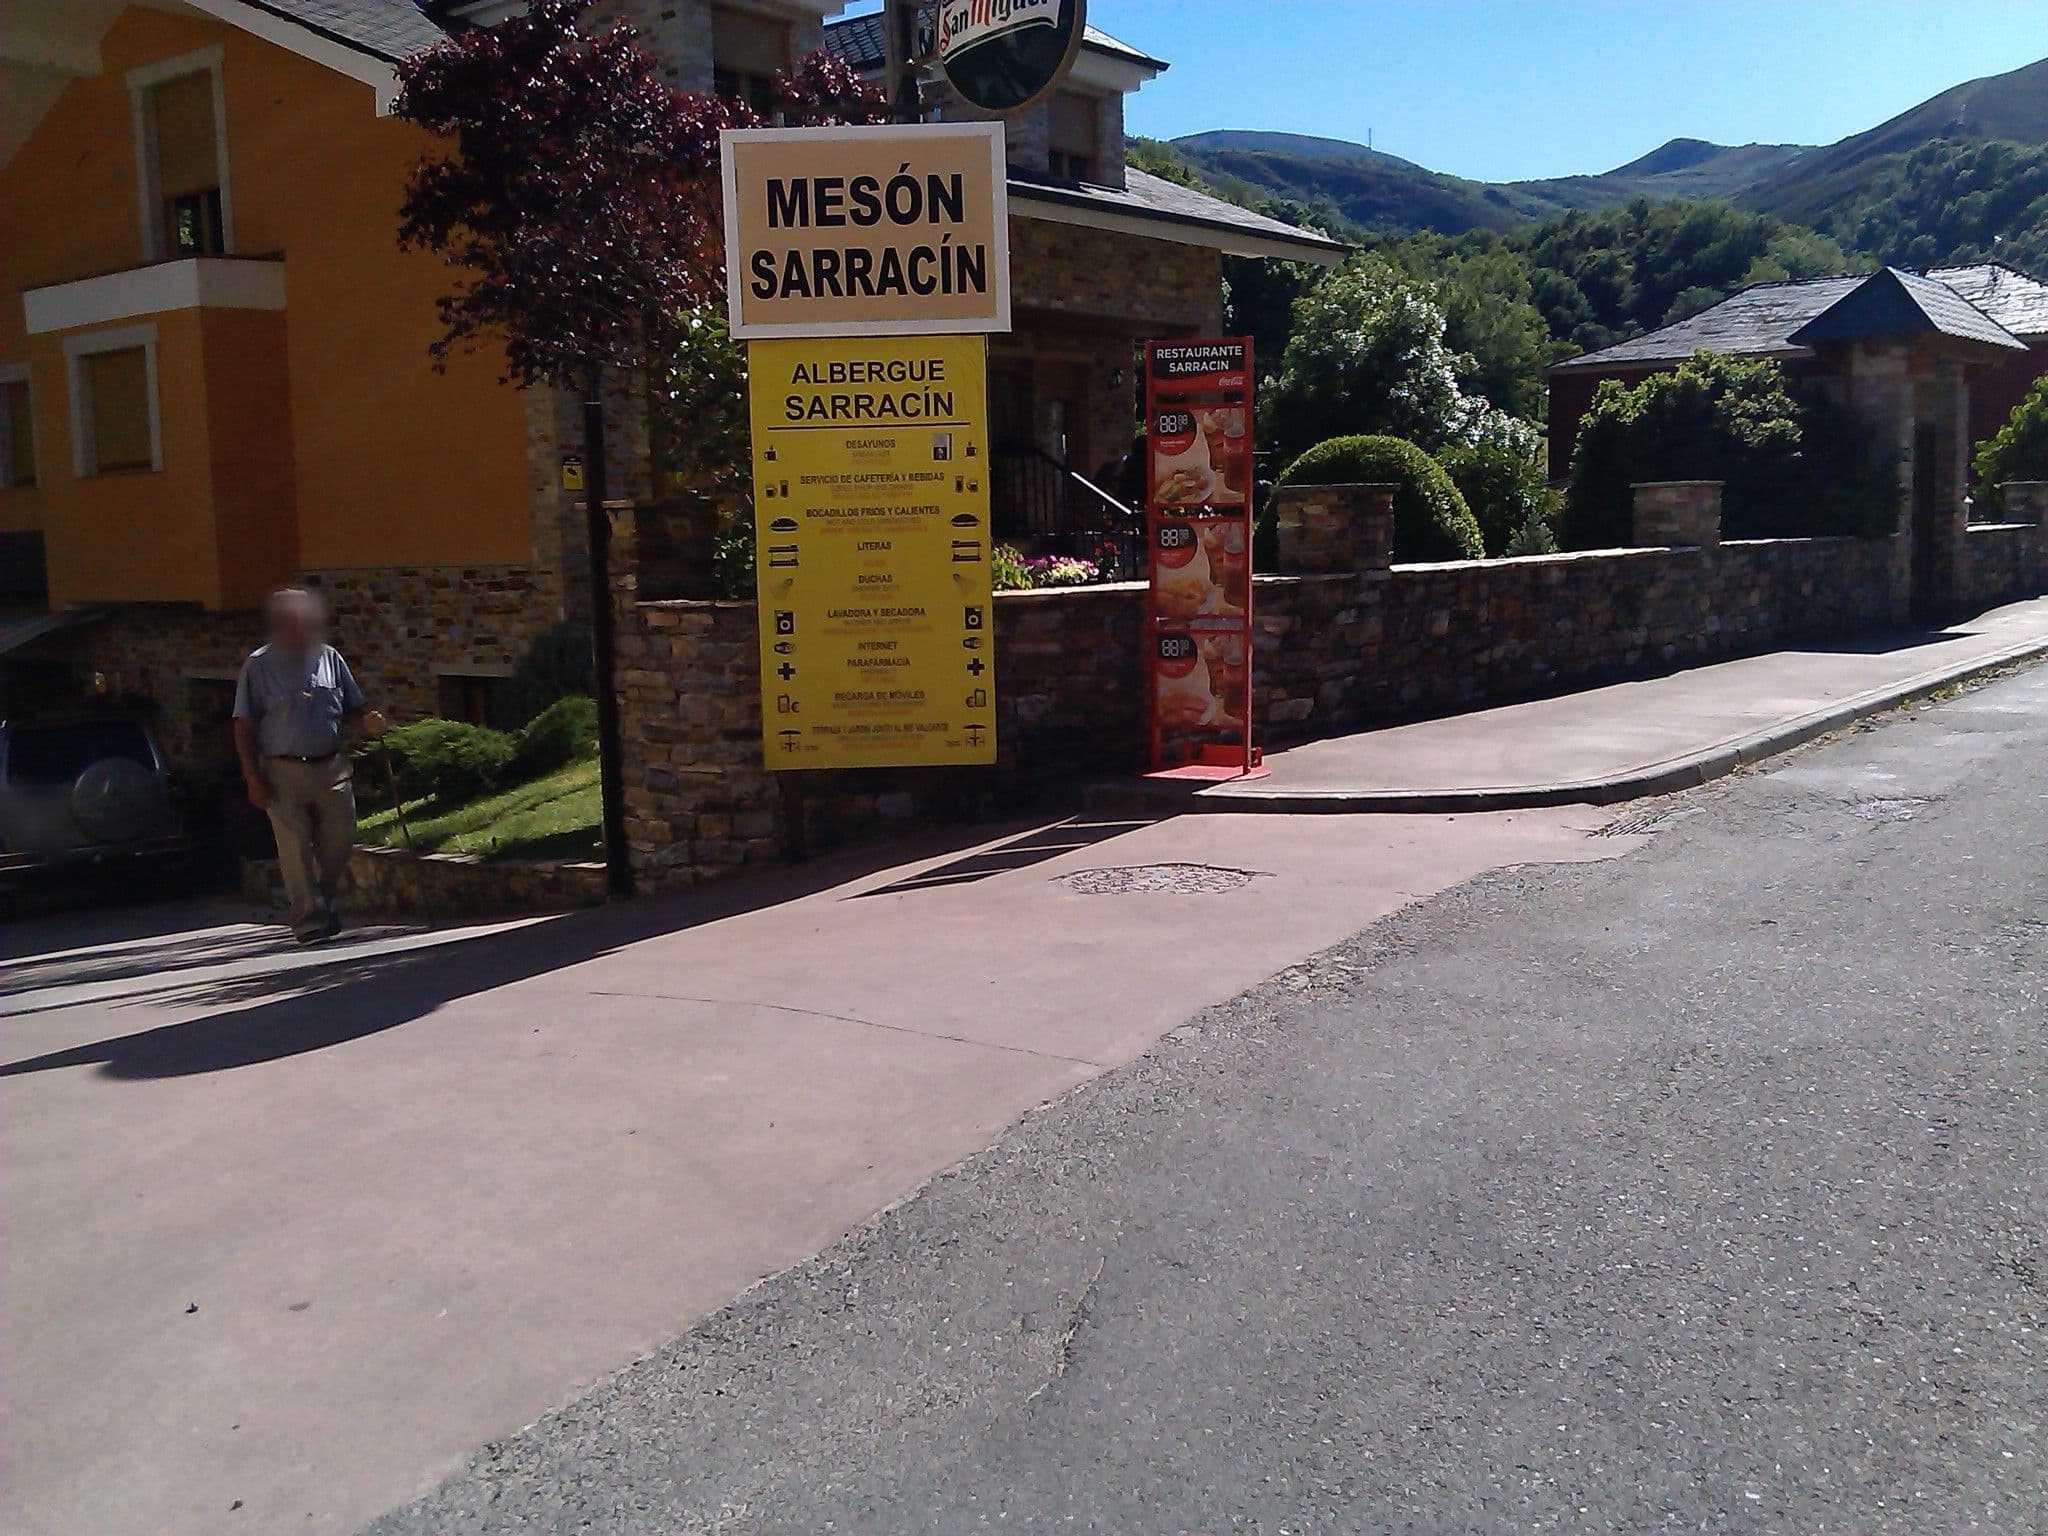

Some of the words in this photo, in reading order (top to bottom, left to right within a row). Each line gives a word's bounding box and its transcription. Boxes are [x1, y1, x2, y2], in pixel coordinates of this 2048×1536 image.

[940, 8, 968, 52] San
[766, 162, 964, 228] MESÓN
[750, 234, 987, 299] SARRACÍN
[1156, 345, 1242, 359] RESTAURANTE
[791, 359, 945, 384] ALBERGUE
[1169, 360, 1229, 372] SARRACIN
[785, 386, 953, 420] SARRACÍN
[845, 438, 896, 449] DESAYUNOS
[800, 474, 838, 485] SERVICIO
[840, 474, 852, 484] DE
[900, 473, 906, 482] Y
[908, 472, 945, 482] BEBIDAS
[806, 508, 859, 518] BOCADILLOS
[888, 507, 893, 516] Y
[894, 505, 940, 516] CALIENTES
[857, 541, 892, 551] LITERAS
[858, 574, 893, 584] DUCHAS
[827, 609, 872, 619] LAVADORA
[872, 608, 878, 618] Y
[880, 607, 926, 617] SECADORA
[857, 641, 898, 651] INTERNET
